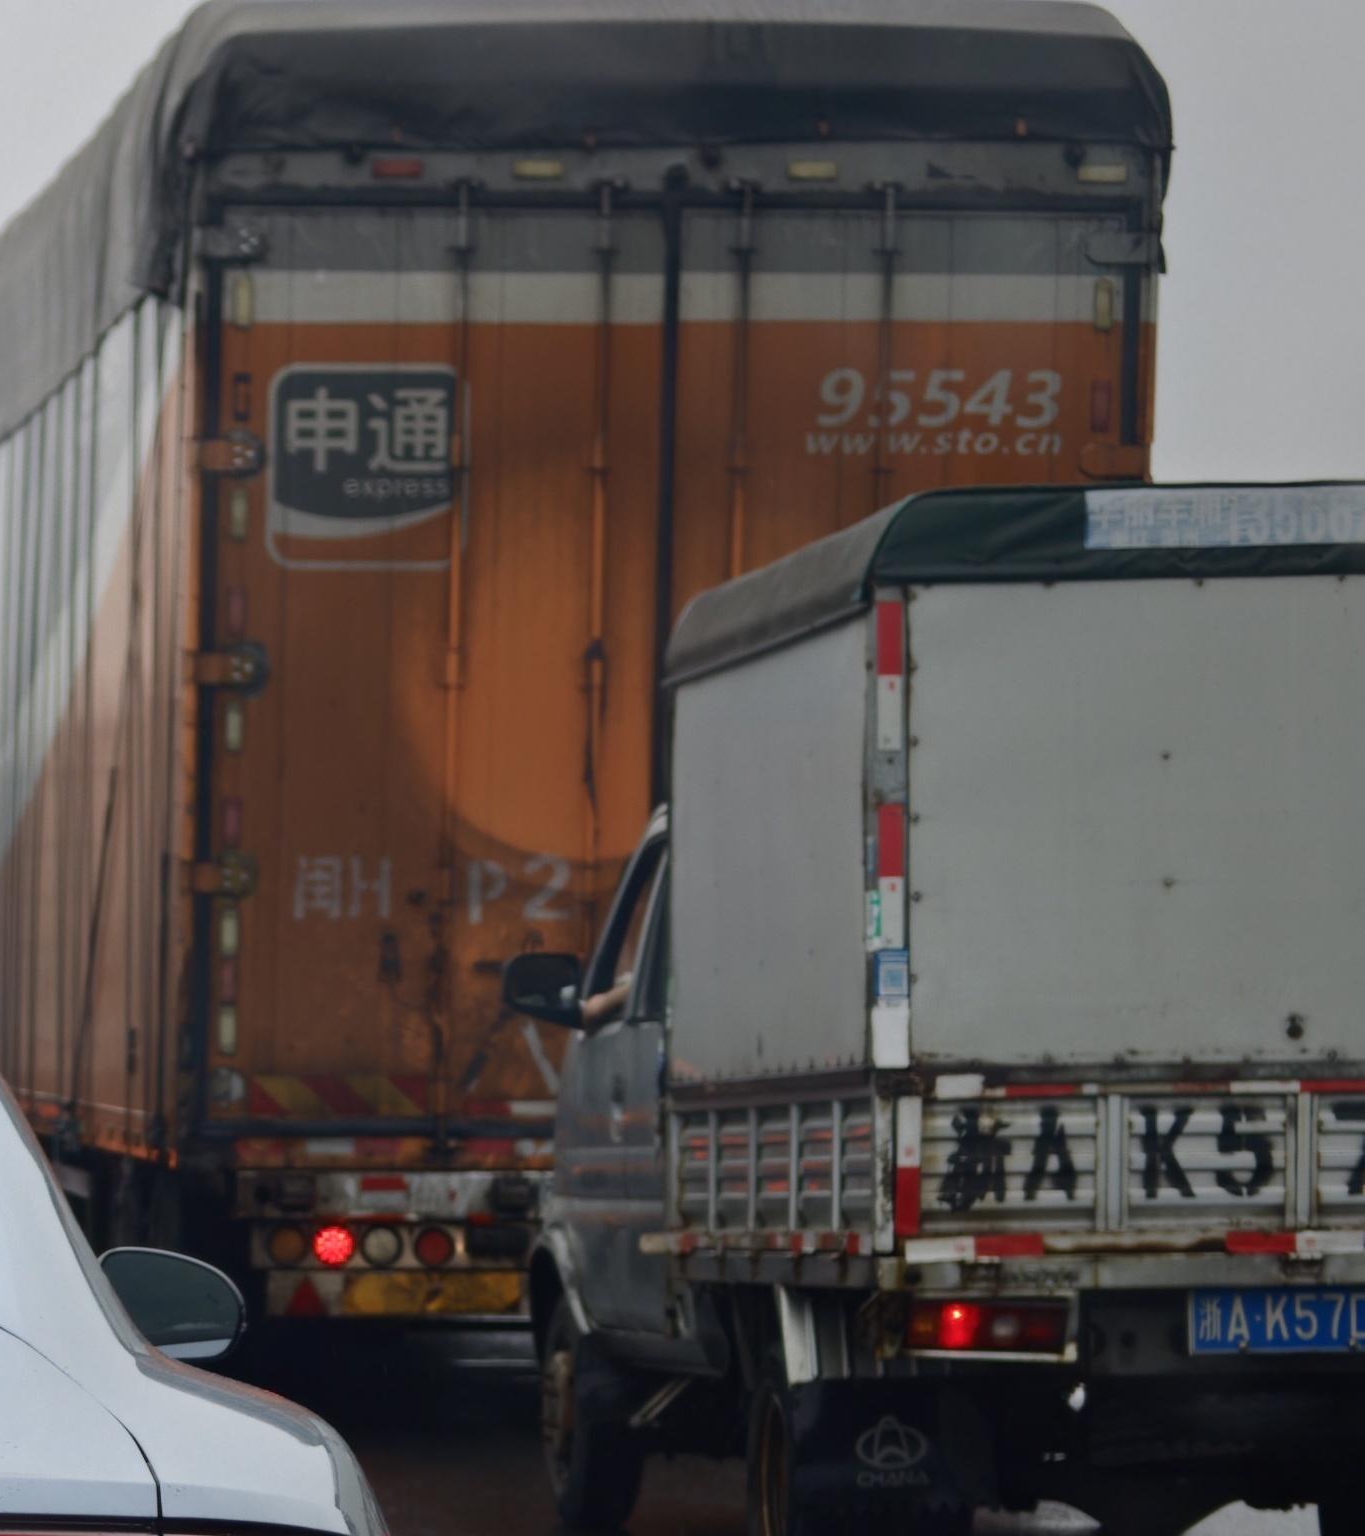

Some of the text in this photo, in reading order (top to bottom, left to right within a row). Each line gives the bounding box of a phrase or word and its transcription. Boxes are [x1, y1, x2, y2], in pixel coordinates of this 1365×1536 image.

[815, 367, 1063, 429] 95543
[286, 384, 449, 474] 申通
[805, 426, 1064, 457] www.sto.cn
[342, 477, 450, 499] express
